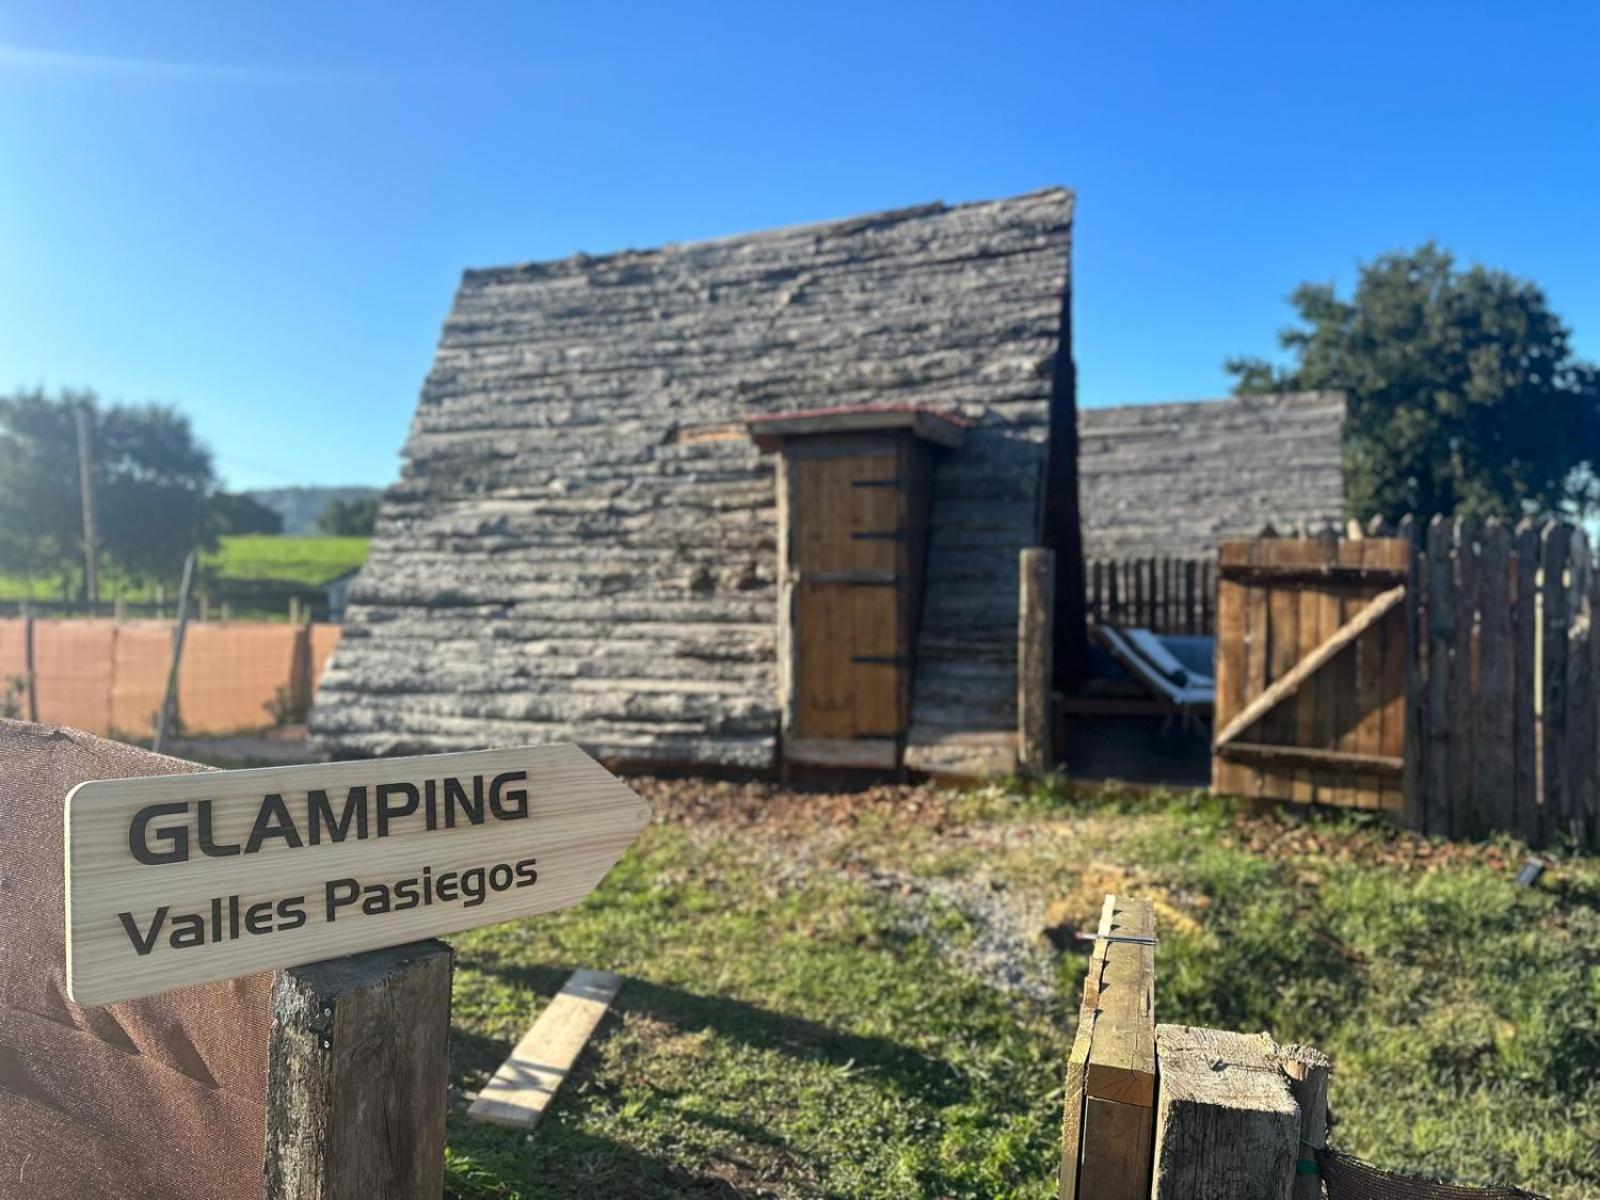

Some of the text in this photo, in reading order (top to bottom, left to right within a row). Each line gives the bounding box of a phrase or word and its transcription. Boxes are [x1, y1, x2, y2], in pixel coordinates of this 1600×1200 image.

[128, 770, 529, 866] GLAMPING
[118, 858, 538, 956] Valles Pasiegos
